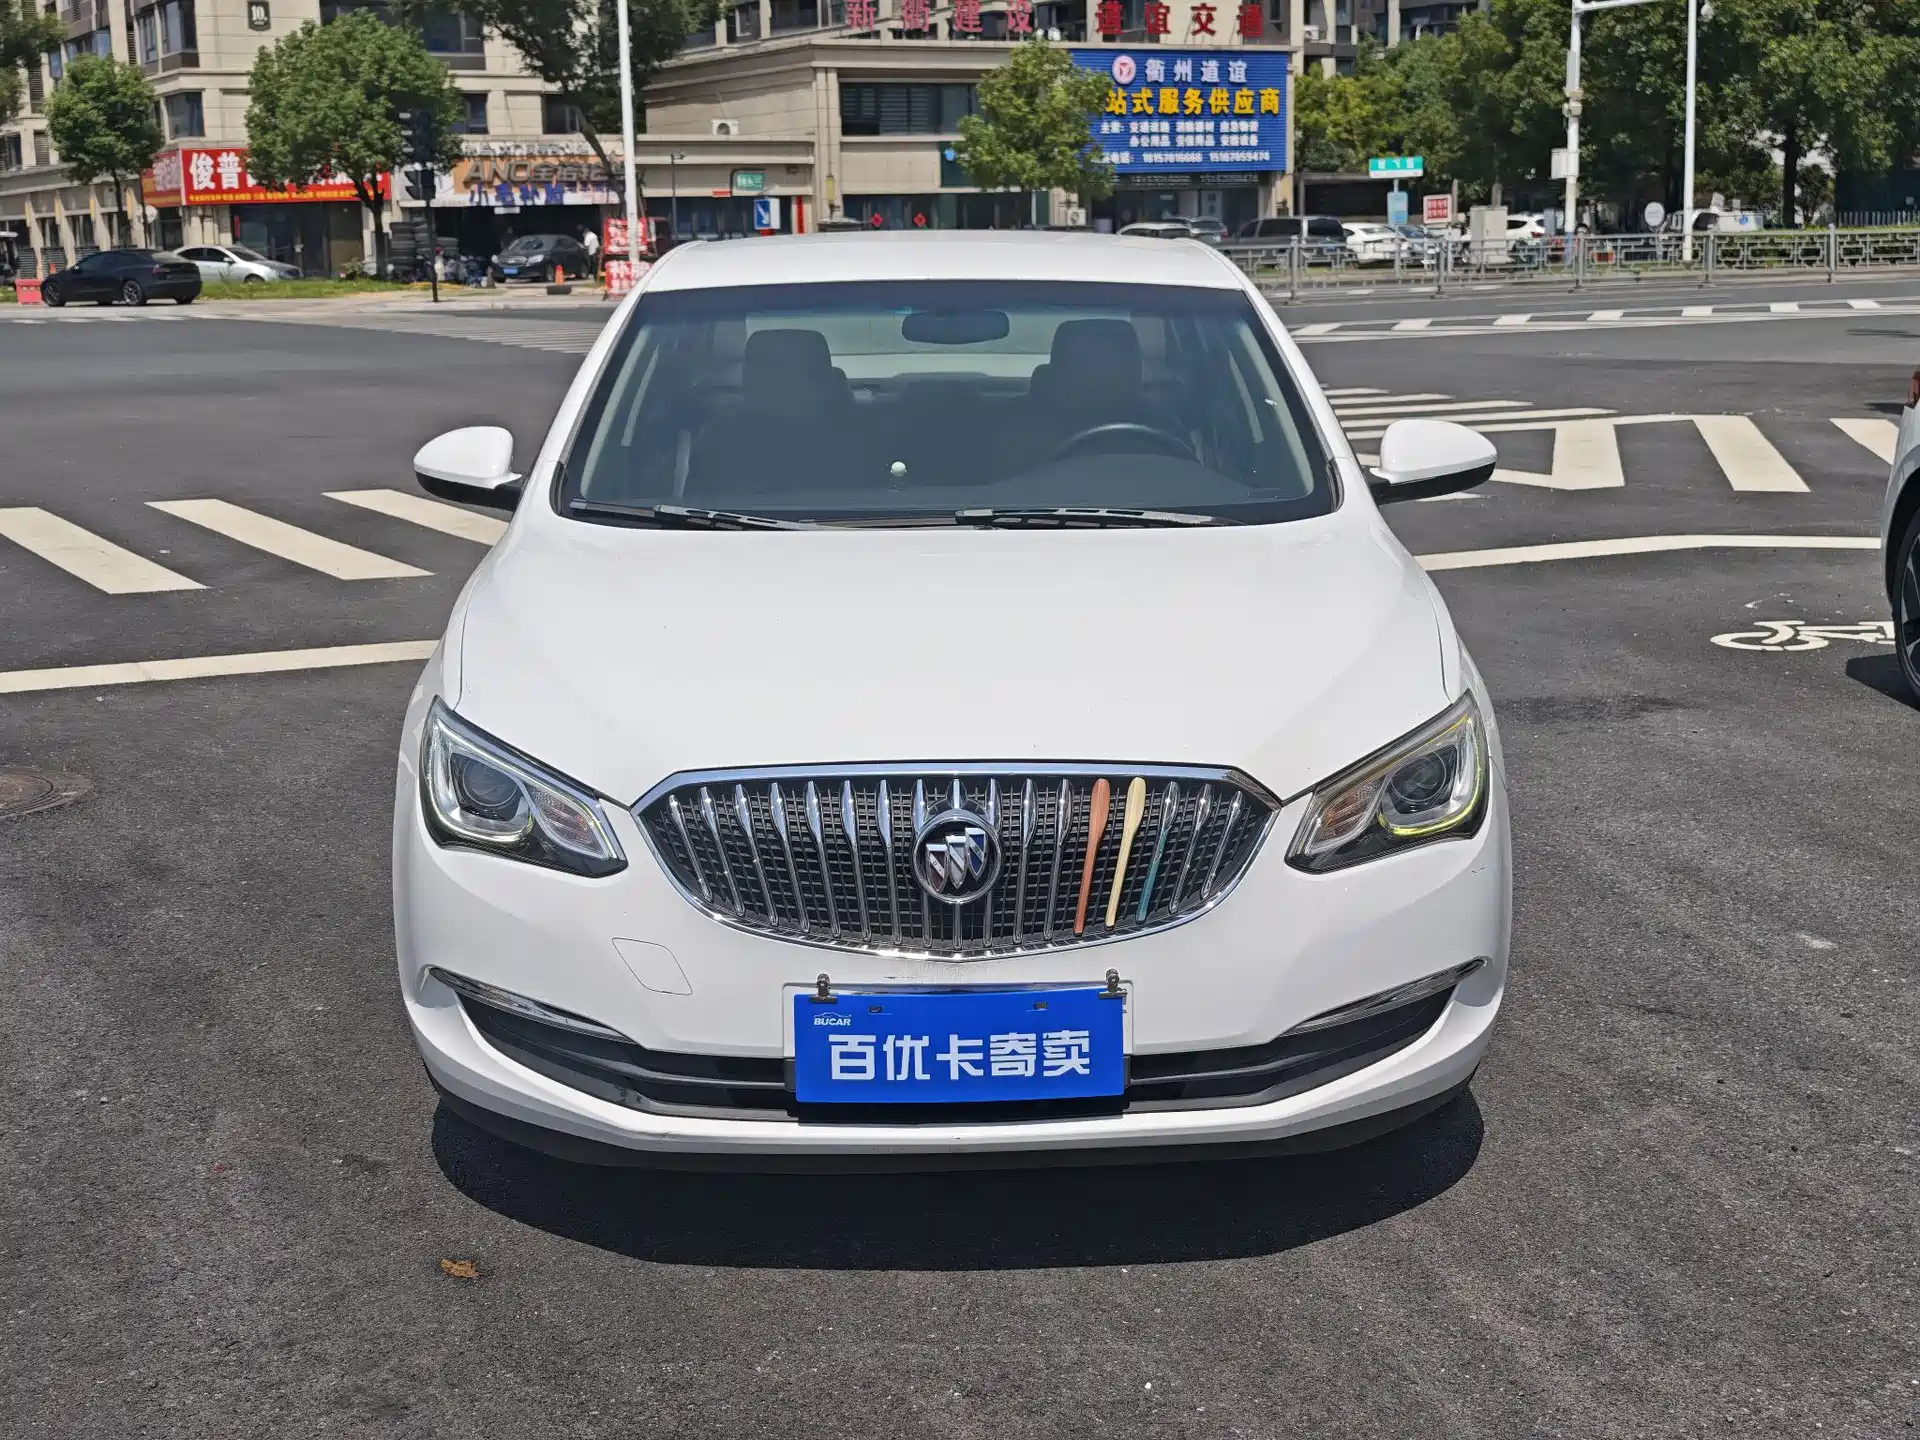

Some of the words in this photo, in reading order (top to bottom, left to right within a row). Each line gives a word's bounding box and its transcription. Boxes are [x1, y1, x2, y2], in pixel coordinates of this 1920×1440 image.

[1144, 57, 1248, 84] 衢州道谊
[813, 1017, 851, 1027] BUCAR
[828, 1029, 1091, 1081] 百优卡寄卖
